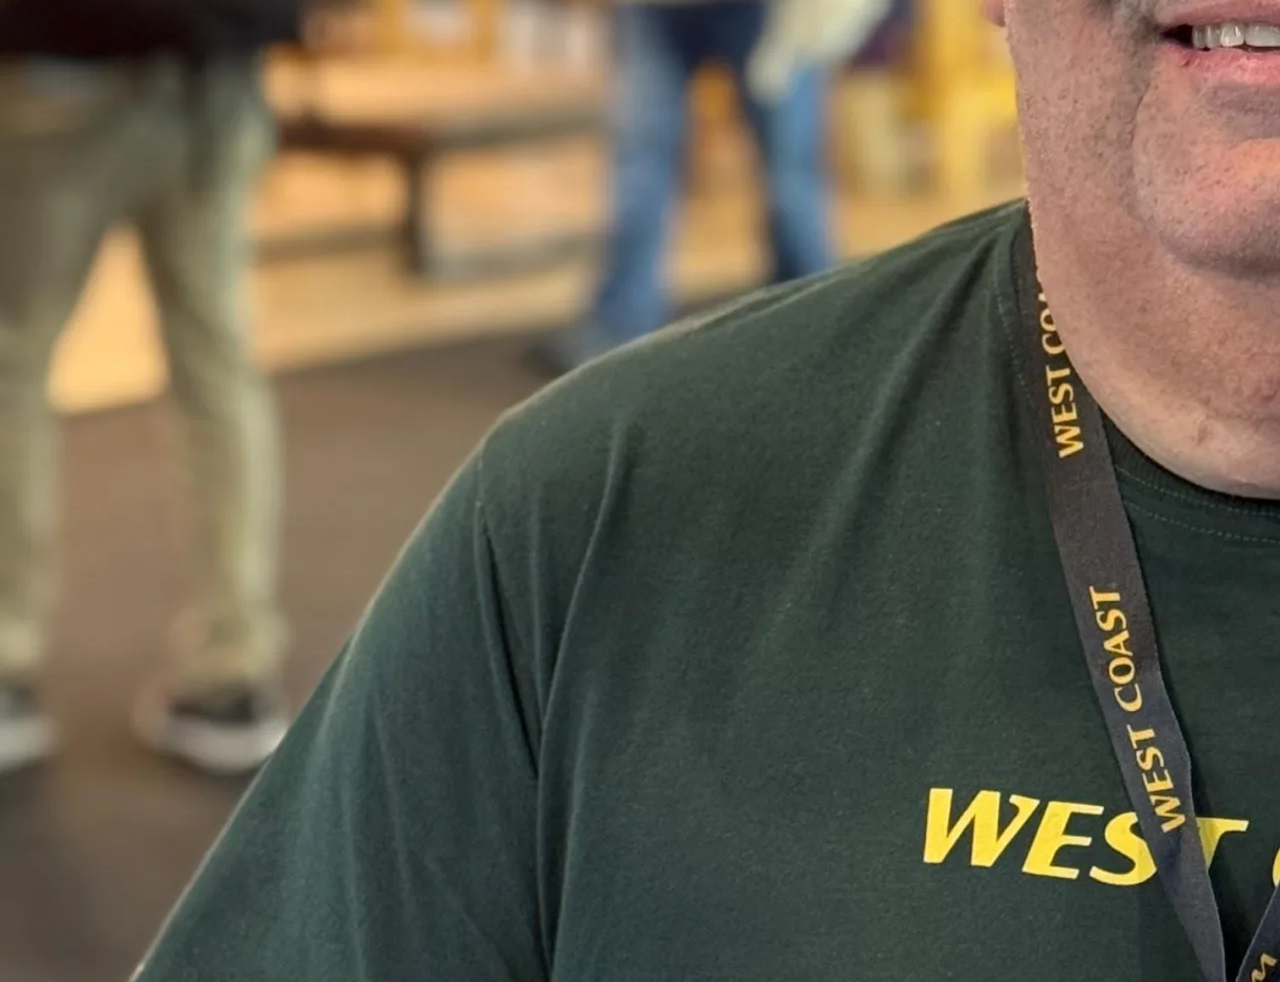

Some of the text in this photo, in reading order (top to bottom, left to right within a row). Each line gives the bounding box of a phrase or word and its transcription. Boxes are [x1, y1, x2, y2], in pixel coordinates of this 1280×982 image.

[1046, 365, 1084, 458] WEST
[1089, 586, 1186, 833] WEST COAST
